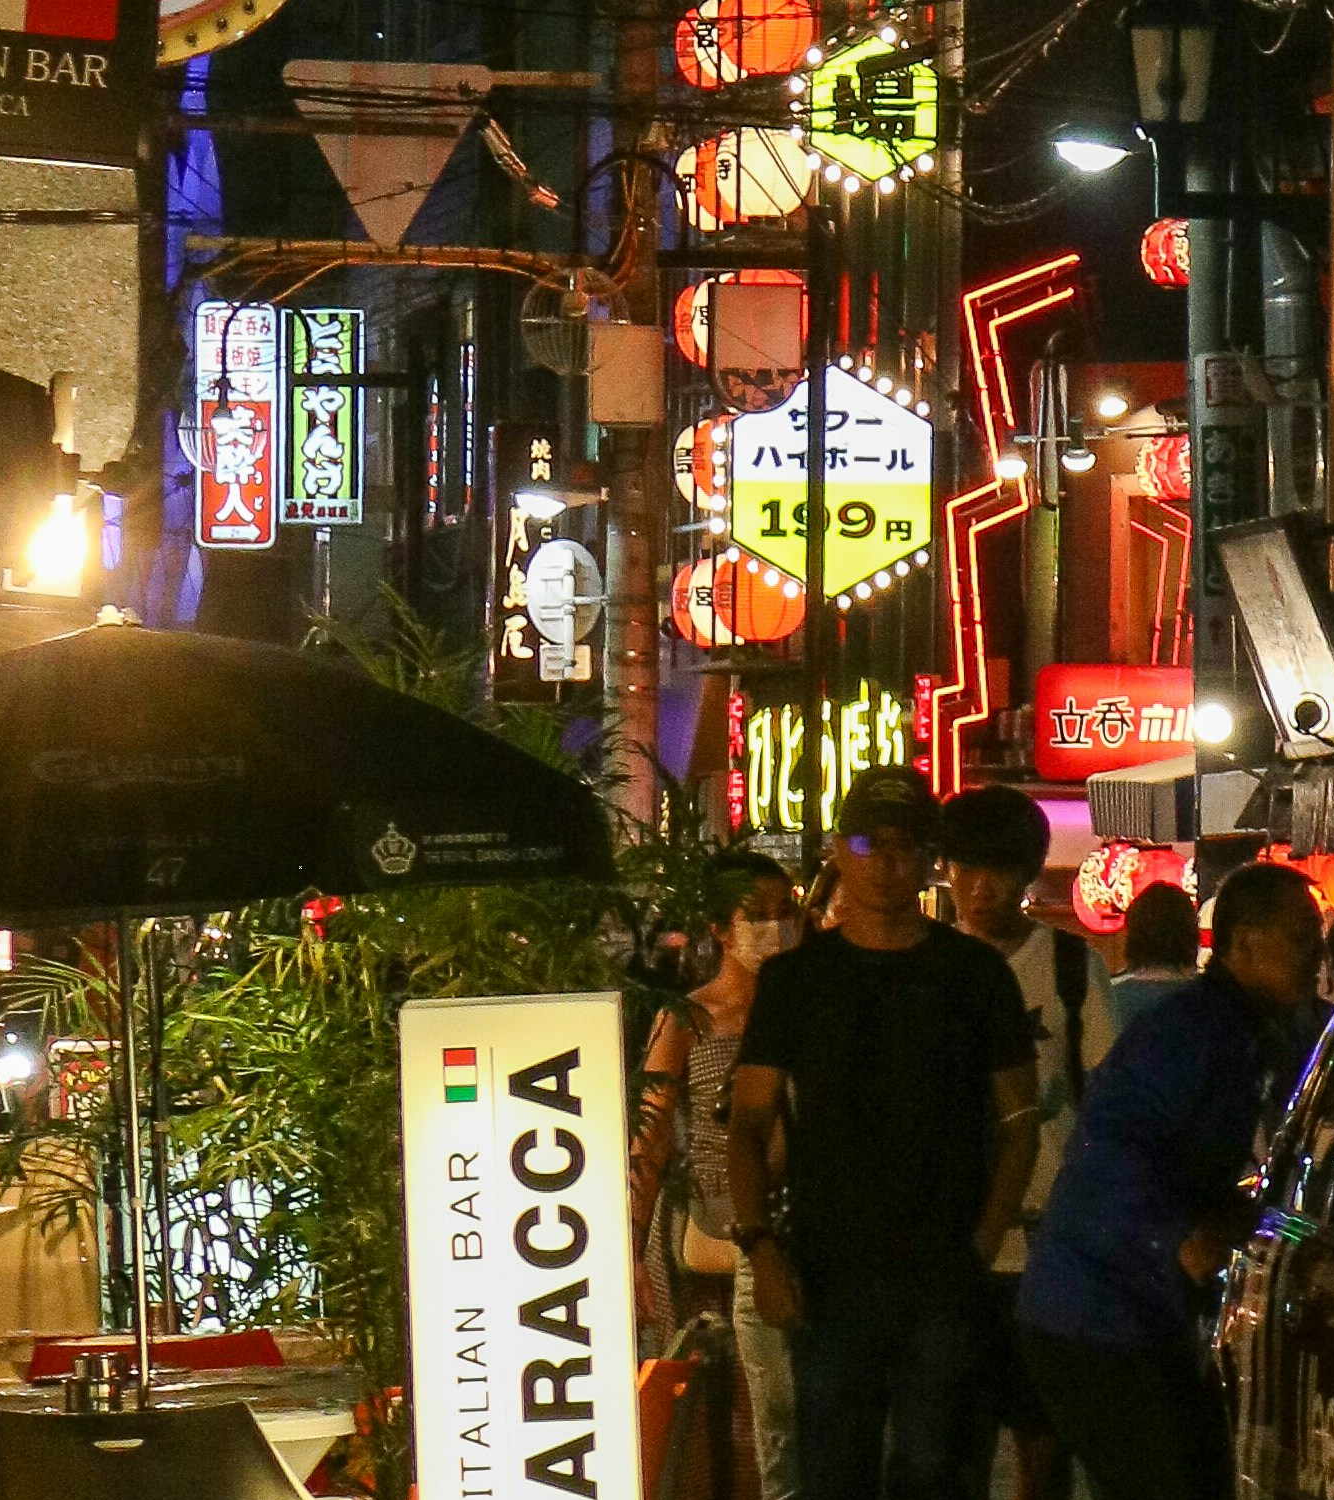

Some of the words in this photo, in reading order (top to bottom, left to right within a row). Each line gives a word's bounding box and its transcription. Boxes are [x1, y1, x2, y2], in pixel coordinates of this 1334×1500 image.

[23, 47, 109, 89] BAR
[529, 436, 553, 482] 焼肉
[445, 1150, 484, 1262] BAR
